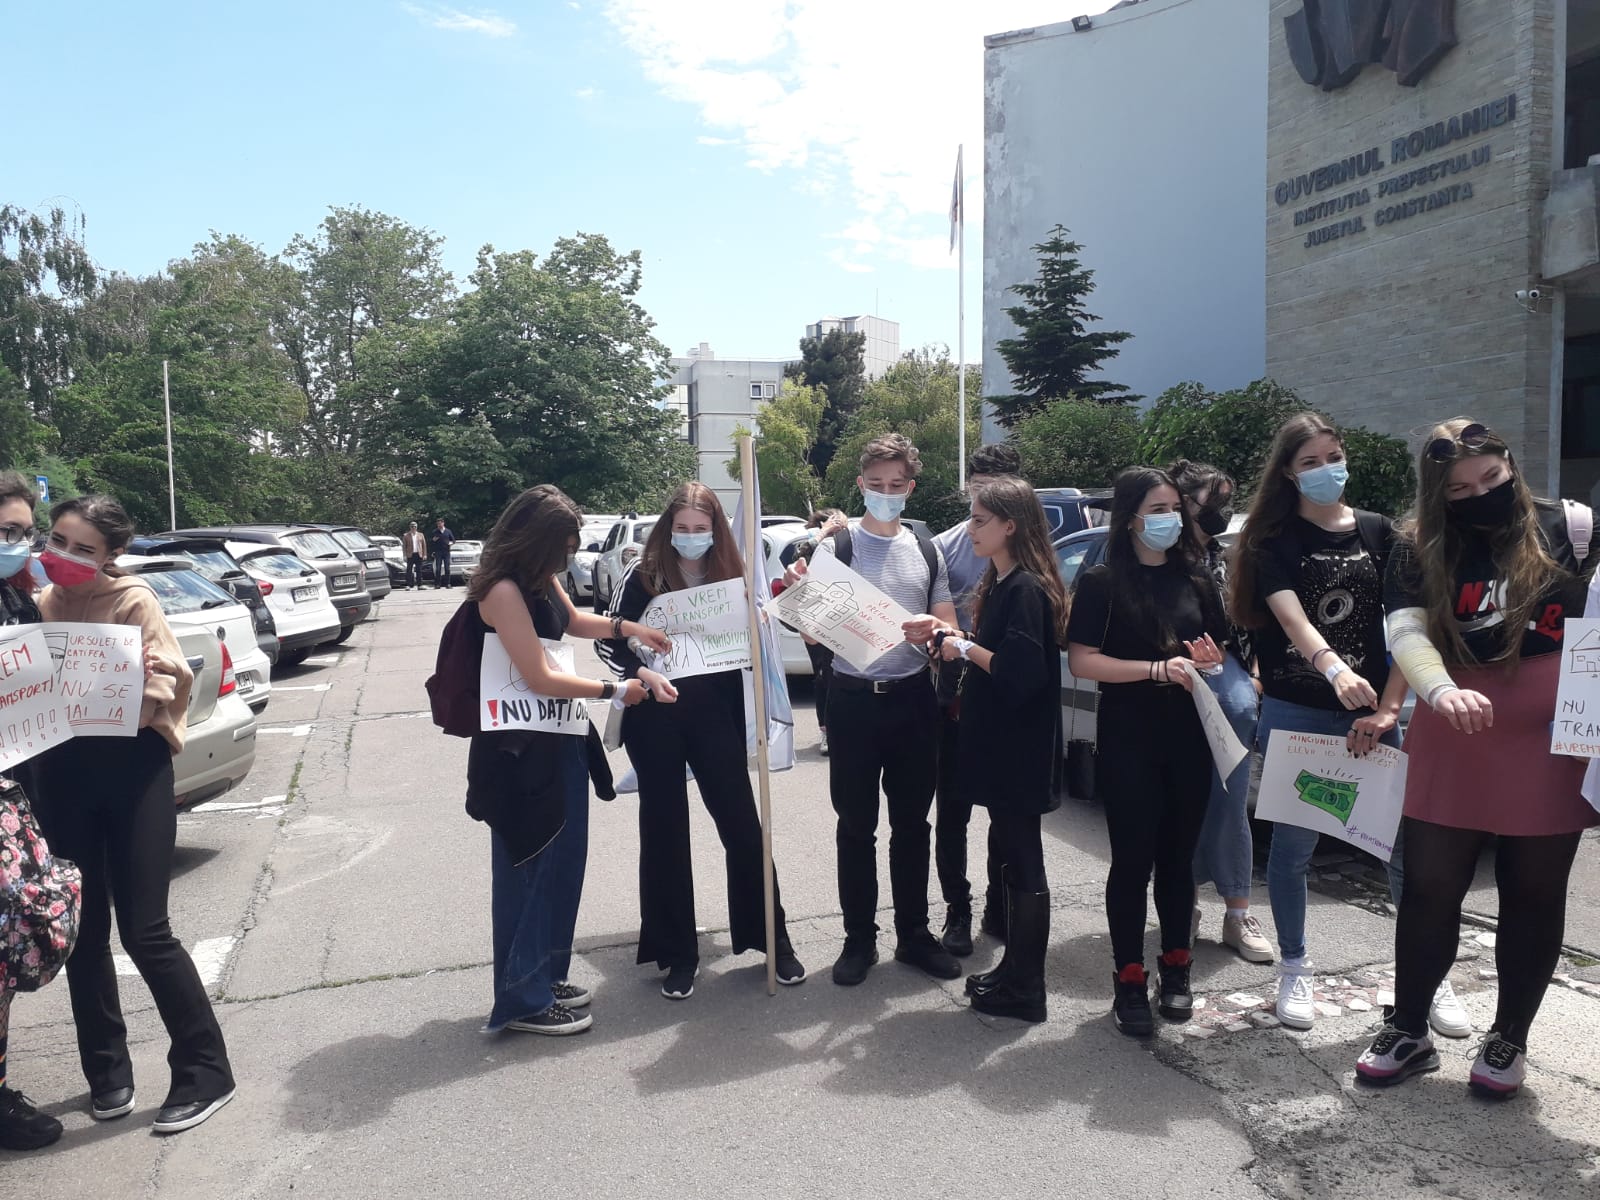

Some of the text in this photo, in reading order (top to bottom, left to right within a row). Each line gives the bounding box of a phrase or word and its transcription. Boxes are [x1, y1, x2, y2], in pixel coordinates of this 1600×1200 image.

[1274, 93, 1516, 206] GUVERNUL ROMANIEI
[1378, 144, 1490, 198] PREFECTULUI
[687, 587, 727, 608] VREM
[123, 638, 135, 646] DE
[65, 660, 80, 671] CE
[90, 662, 108, 673] SE
[61, 680, 133, 699] NU SE
[501, 699, 531, 724] NU
[1562, 699, 1585, 715] NU
